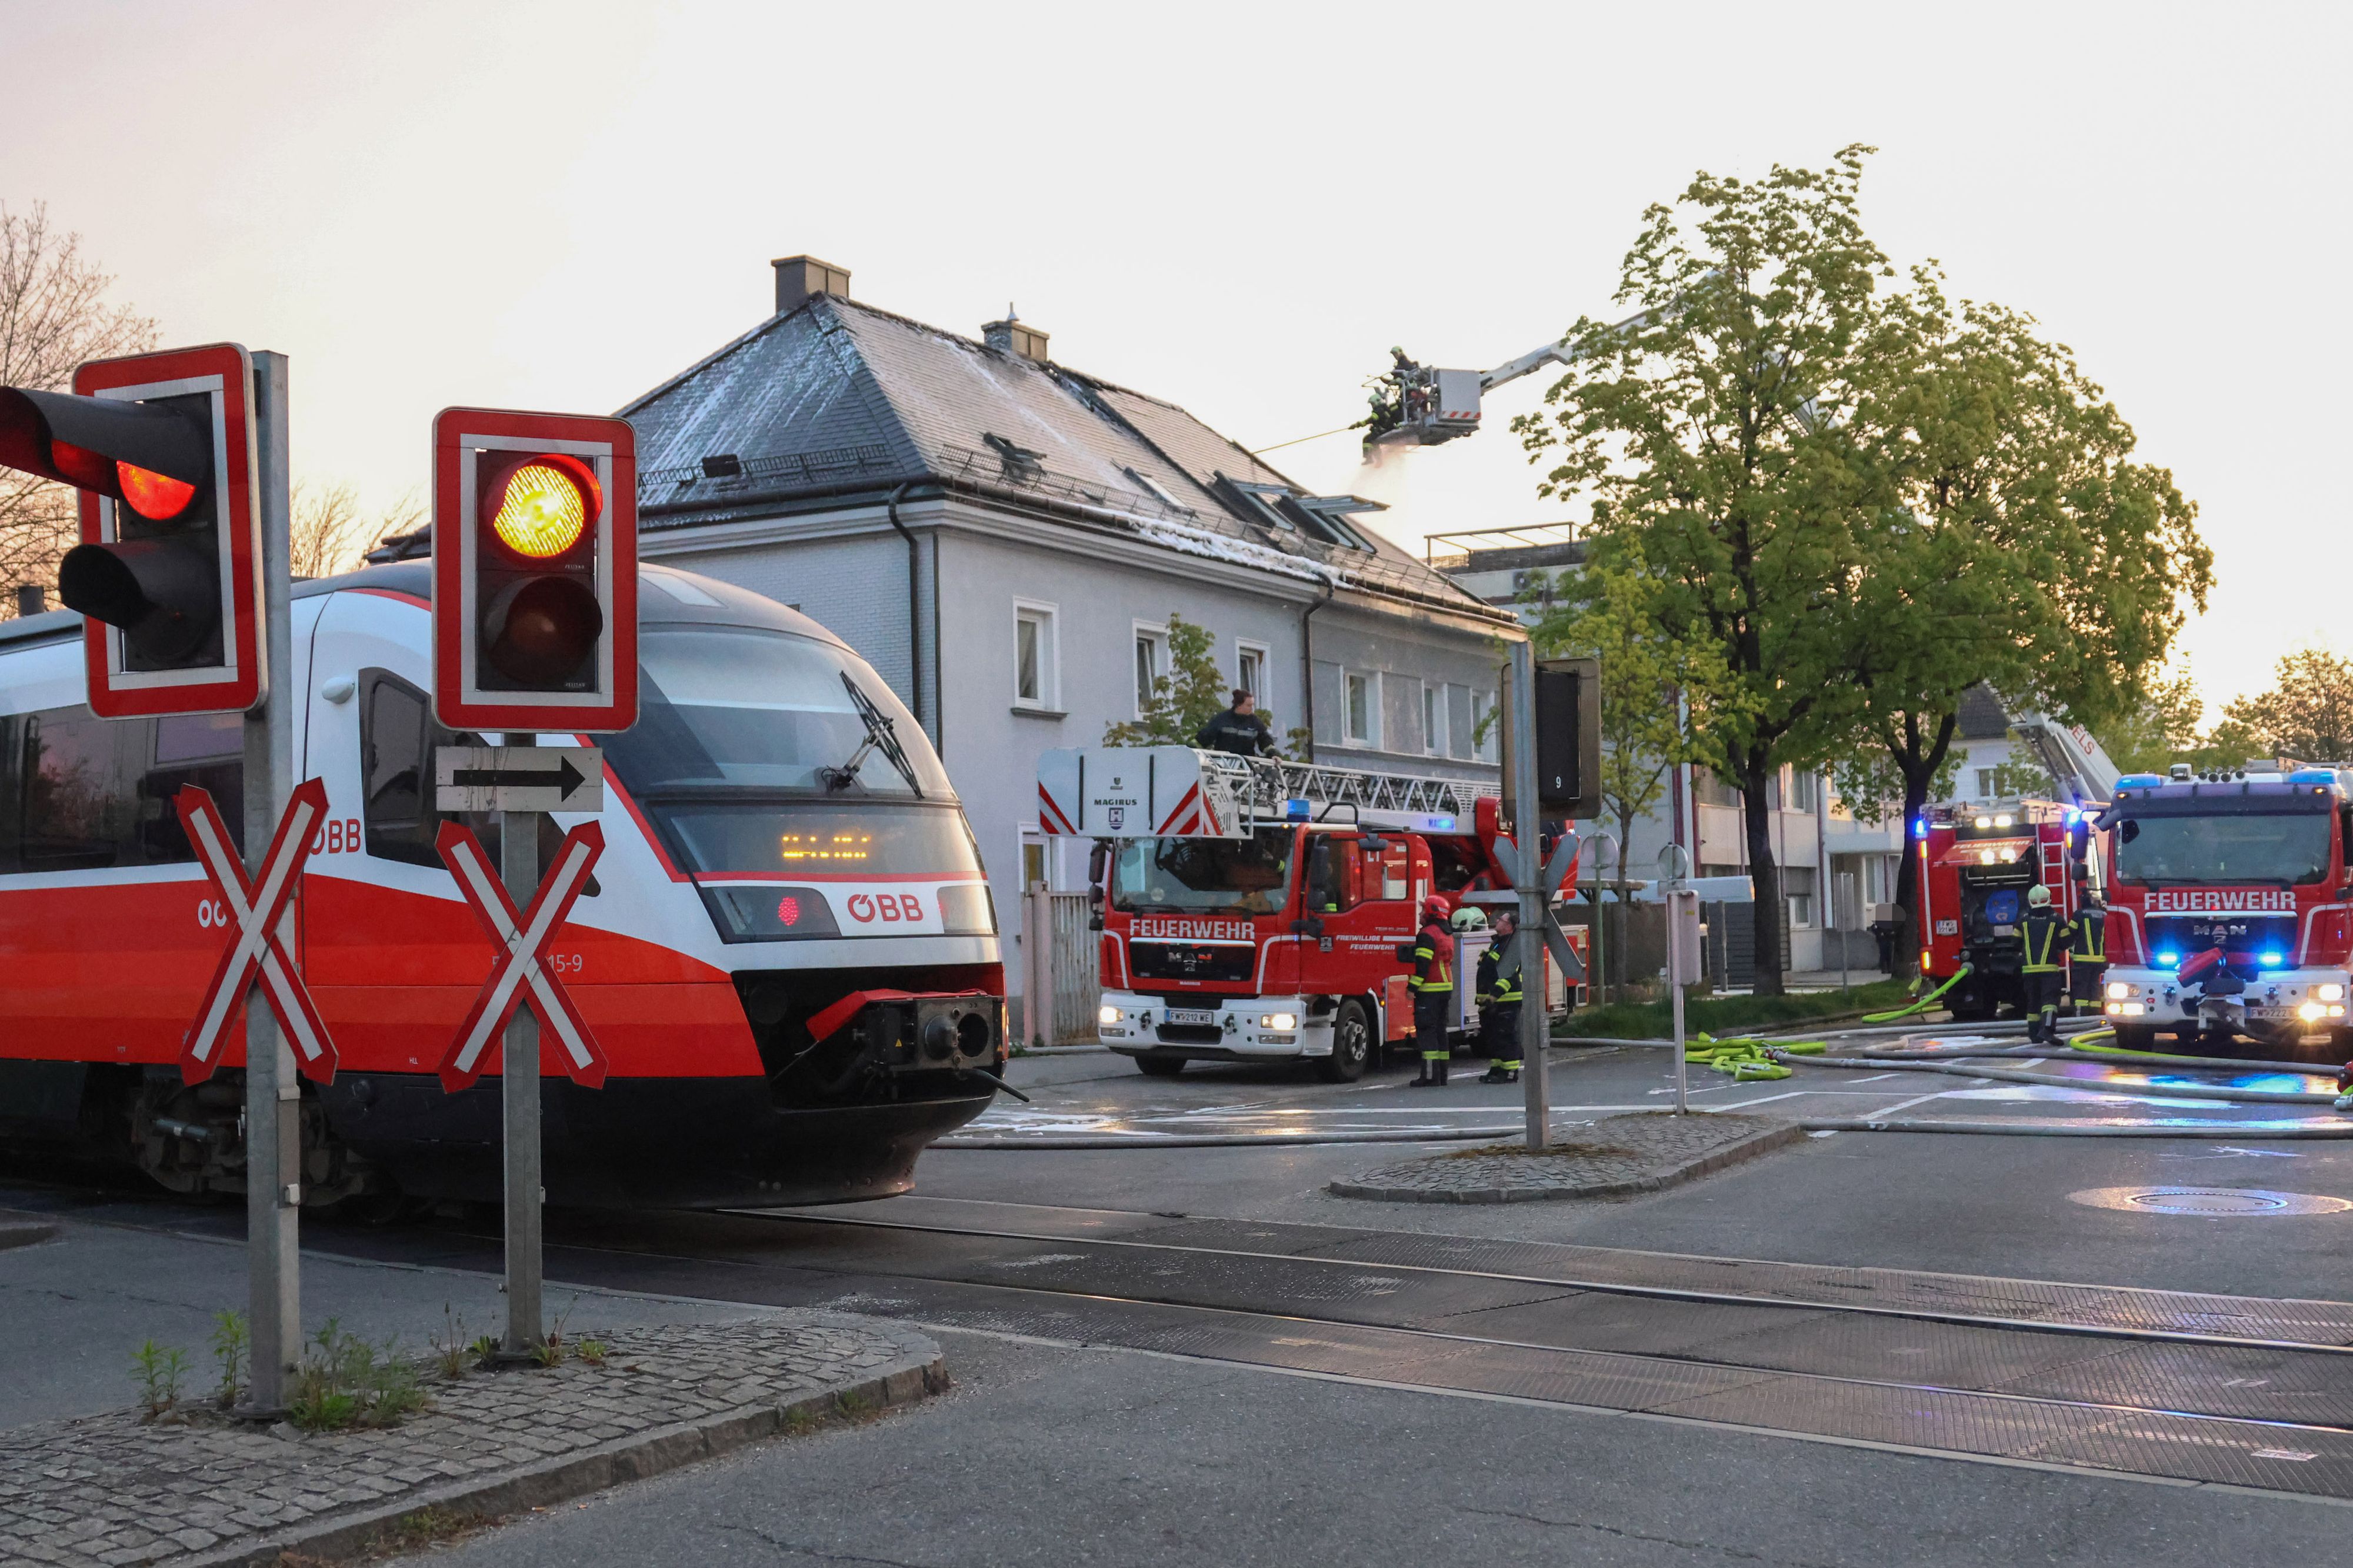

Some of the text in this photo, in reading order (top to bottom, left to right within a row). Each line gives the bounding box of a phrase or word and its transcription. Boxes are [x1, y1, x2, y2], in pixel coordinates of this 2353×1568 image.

[2072, 727, 2094, 755] ELS
[1556, 776, 1561, 789] 9
[847, 894, 924, 923] ÖBB
[2144, 891, 2296, 910] FEUERWEHR
[1129, 919, 1255, 939] FEUERWEHR
[2194, 925, 2247, 936] MAN
[1185, 1013, 1198, 1022] 212
